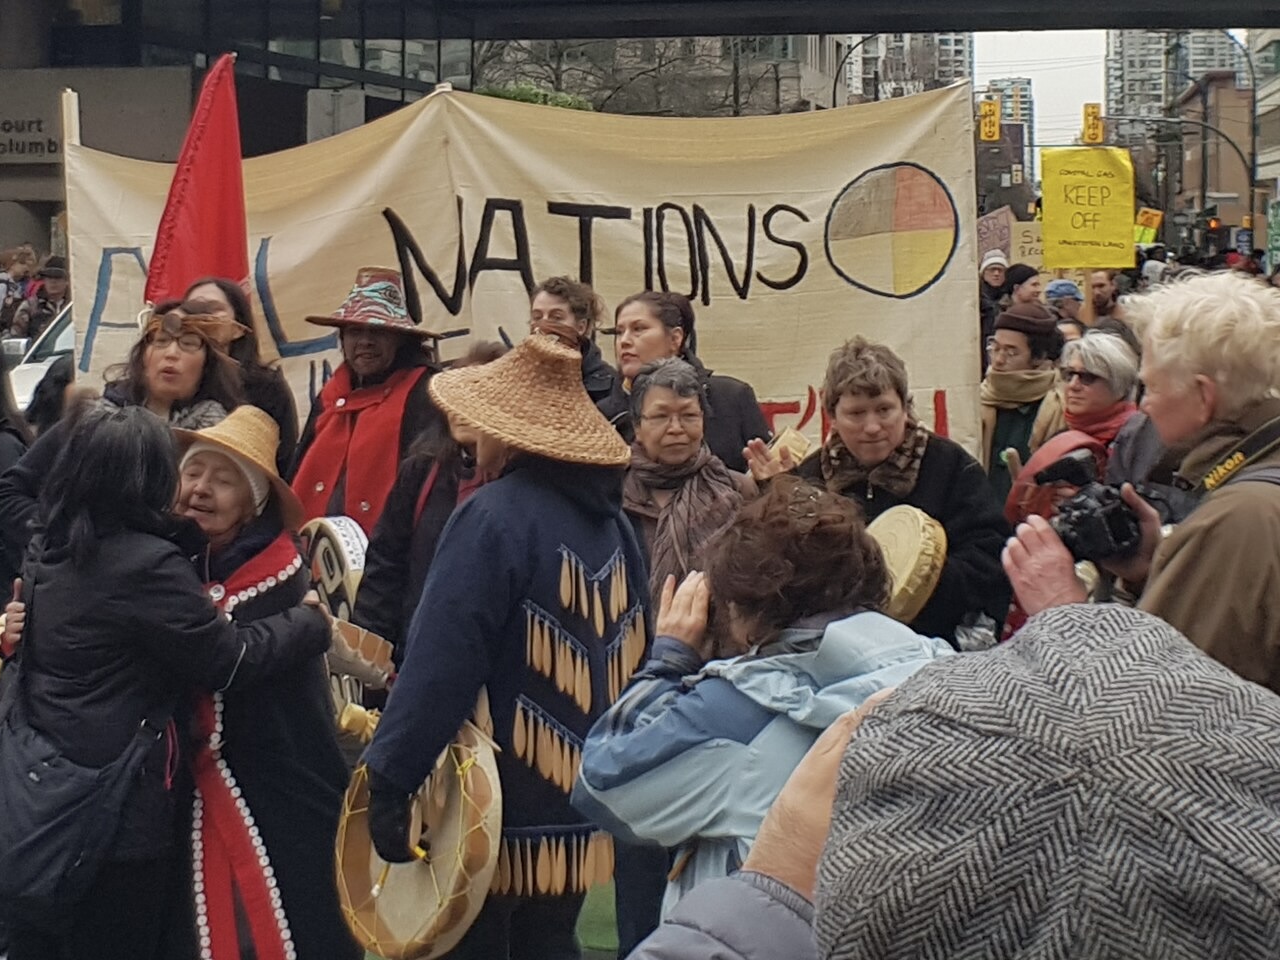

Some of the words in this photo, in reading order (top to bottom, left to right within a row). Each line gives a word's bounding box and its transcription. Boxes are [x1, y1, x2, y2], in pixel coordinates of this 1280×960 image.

[1063, 184, 1112, 207] KEEP
[1070, 211, 1102, 230] OFF
[381, 195, 810, 324] NATIONS
[1202, 450, 1247, 490] Nikon
